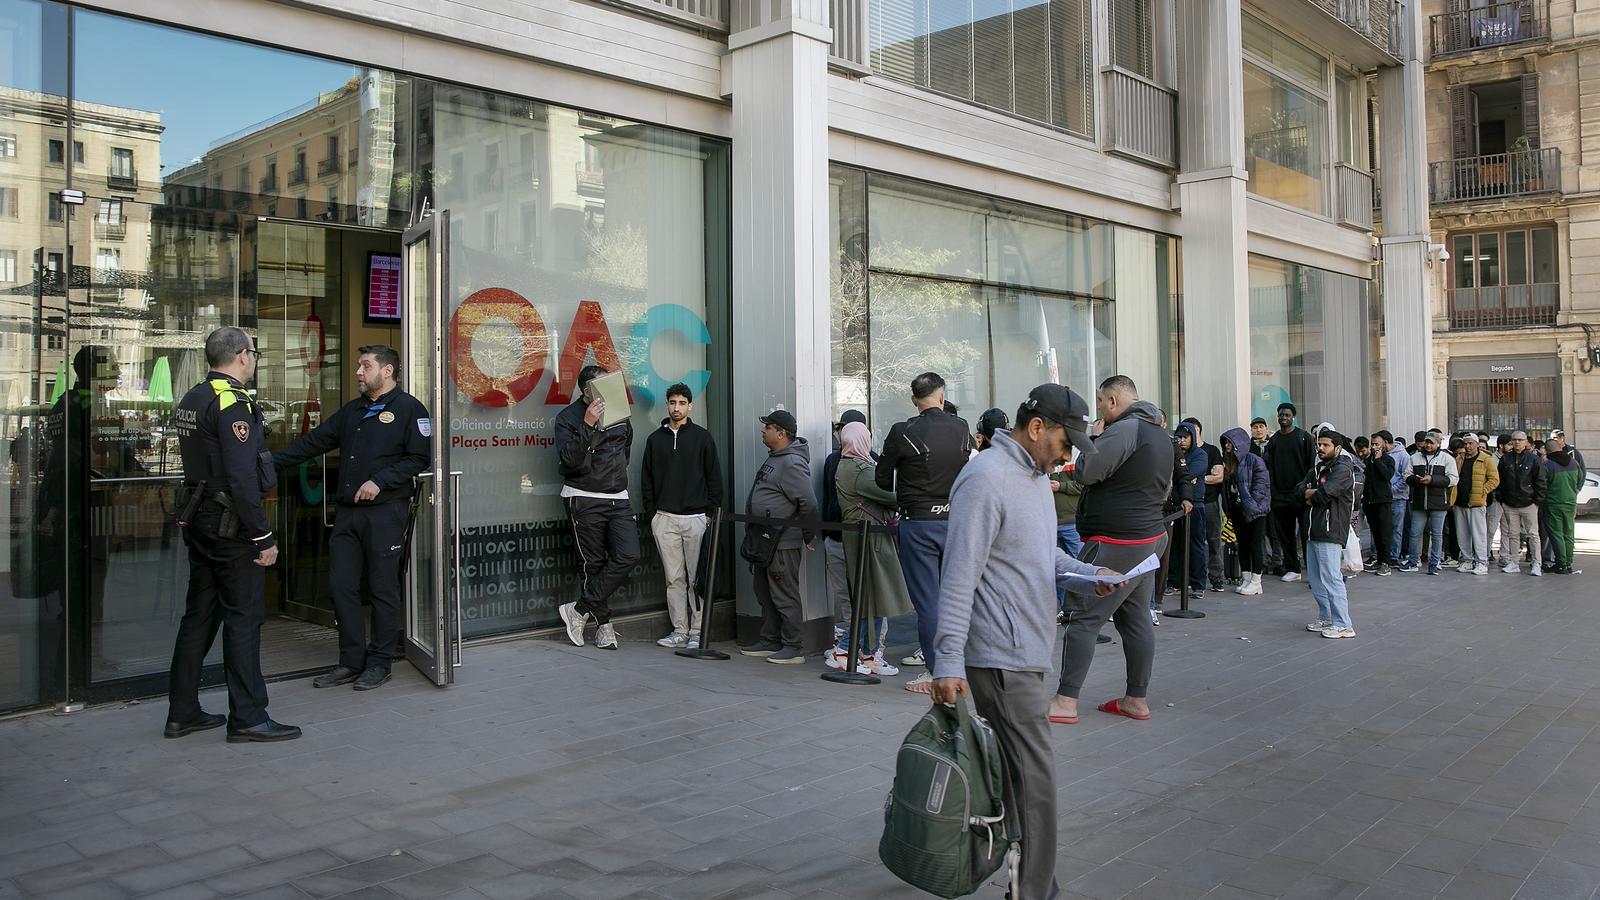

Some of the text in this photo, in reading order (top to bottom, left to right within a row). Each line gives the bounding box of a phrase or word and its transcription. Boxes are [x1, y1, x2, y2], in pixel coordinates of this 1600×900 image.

[449, 287, 712, 409] OAC
[1490, 365, 1514, 373] Begudes
[175, 408, 197, 423] POLICIA
[451, 417, 491, 431] Oficina
[495, 417, 545, 430] d'Atenció
[452, 434, 555, 451] Plaça Sant Miqu
[486, 540, 516, 554] OAC
[526, 556, 555, 570] OAC
[486, 581, 517, 596] OAC
[527, 596, 555, 610] OAC
